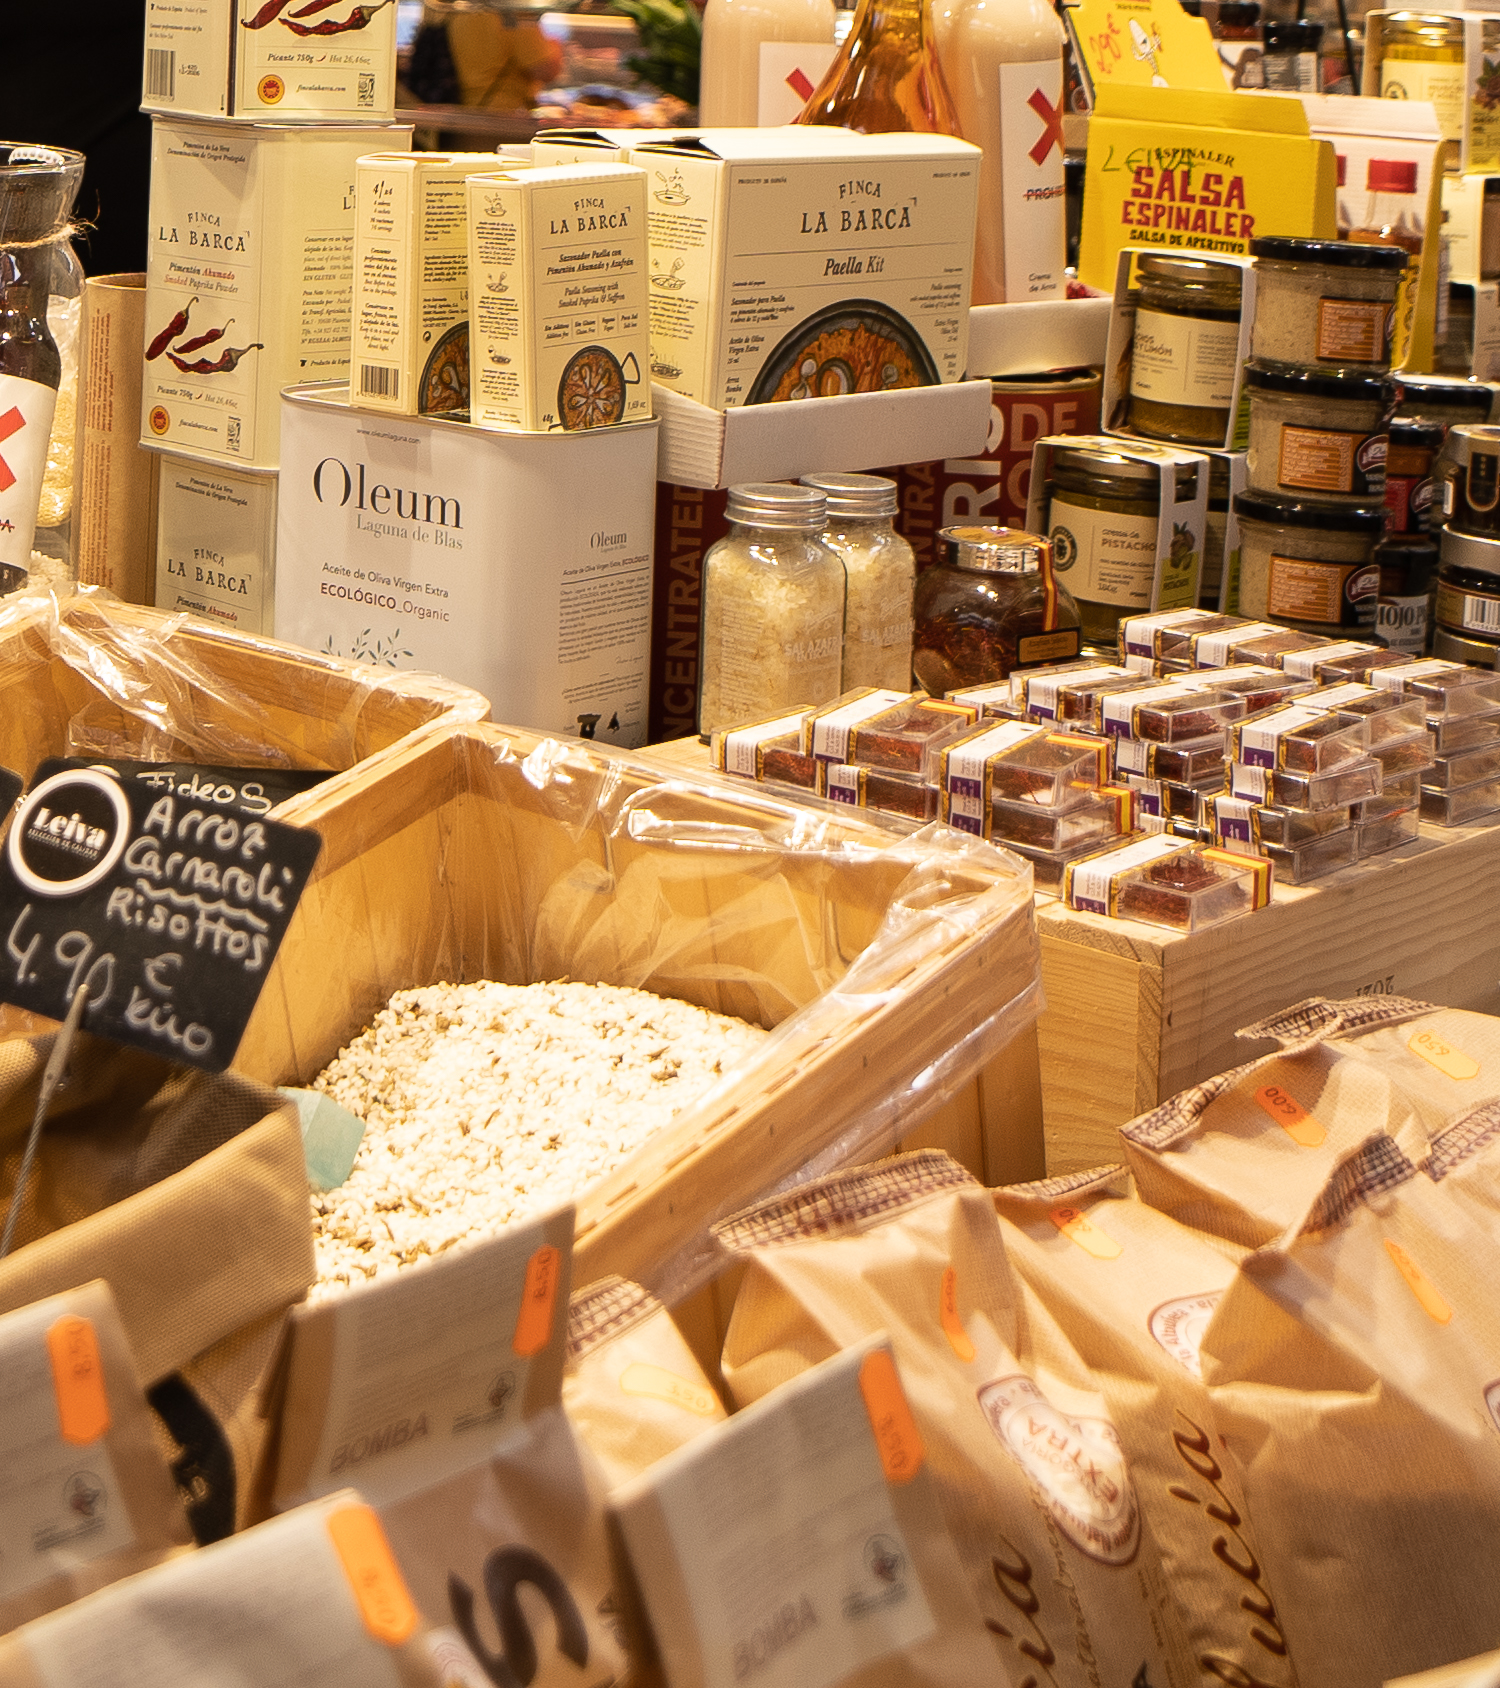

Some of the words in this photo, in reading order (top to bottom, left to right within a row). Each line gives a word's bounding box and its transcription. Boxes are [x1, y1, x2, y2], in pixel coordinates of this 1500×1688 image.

[267, 53, 295, 62] Picante
[574, 197, 605, 211] FINCA
[838, 180, 882, 199] FINCA
[1131, 165, 1246, 210] SALSA
[188, 212, 221, 227] FINCA
[550, 219, 569, 234] LA
[578, 212, 628, 232] BARCA
[800, 211, 828, 234] LA
[840, 206, 912, 232] BARCA
[1121, 200, 1256, 239] ESPINALER
[159, 226, 179, 243] LA
[190, 230, 246, 252] BARCA
[1129, 228, 1166, 244] SALSA
[1169, 234, 1183, 246] DE
[1185, 236, 1245, 254] APERITIVO
[169, 262, 201, 275] Pimentón
[202, 268, 235, 280] Ahumado
[823, 255, 863, 277] Paella
[866, 255, 885, 274] Kit
[313, 457, 464, 530] Oleum
[356, 513, 408, 539] Laguna
[412, 526, 429, 543] de
[434, 529, 463, 550] Blas
[193, 549, 225, 567] FINCA
[168, 559, 186, 577] LA
[195, 567, 248, 595] BARCA
[322, 562, 351, 577] Aceite
[354, 568, 365, 580] de
[368, 571, 391, 586] Oliva
[393, 576, 422, 593] Virgen
[425, 584, 449, 598] Extra
[31, 807, 109, 850] Leiva
[143, 795, 268, 859] Arroz
[124, 836, 295, 911] Carnaroli
[106, 886, 271, 971] Risottos
[6, 903, 117, 1012] 4.90
[144, 952, 183, 993] €
[326, 1408, 433, 1477] BOMBA
[1026, 1415, 1120, 1505] EXTRA
[730, 1594, 821, 1683] BOMBA
